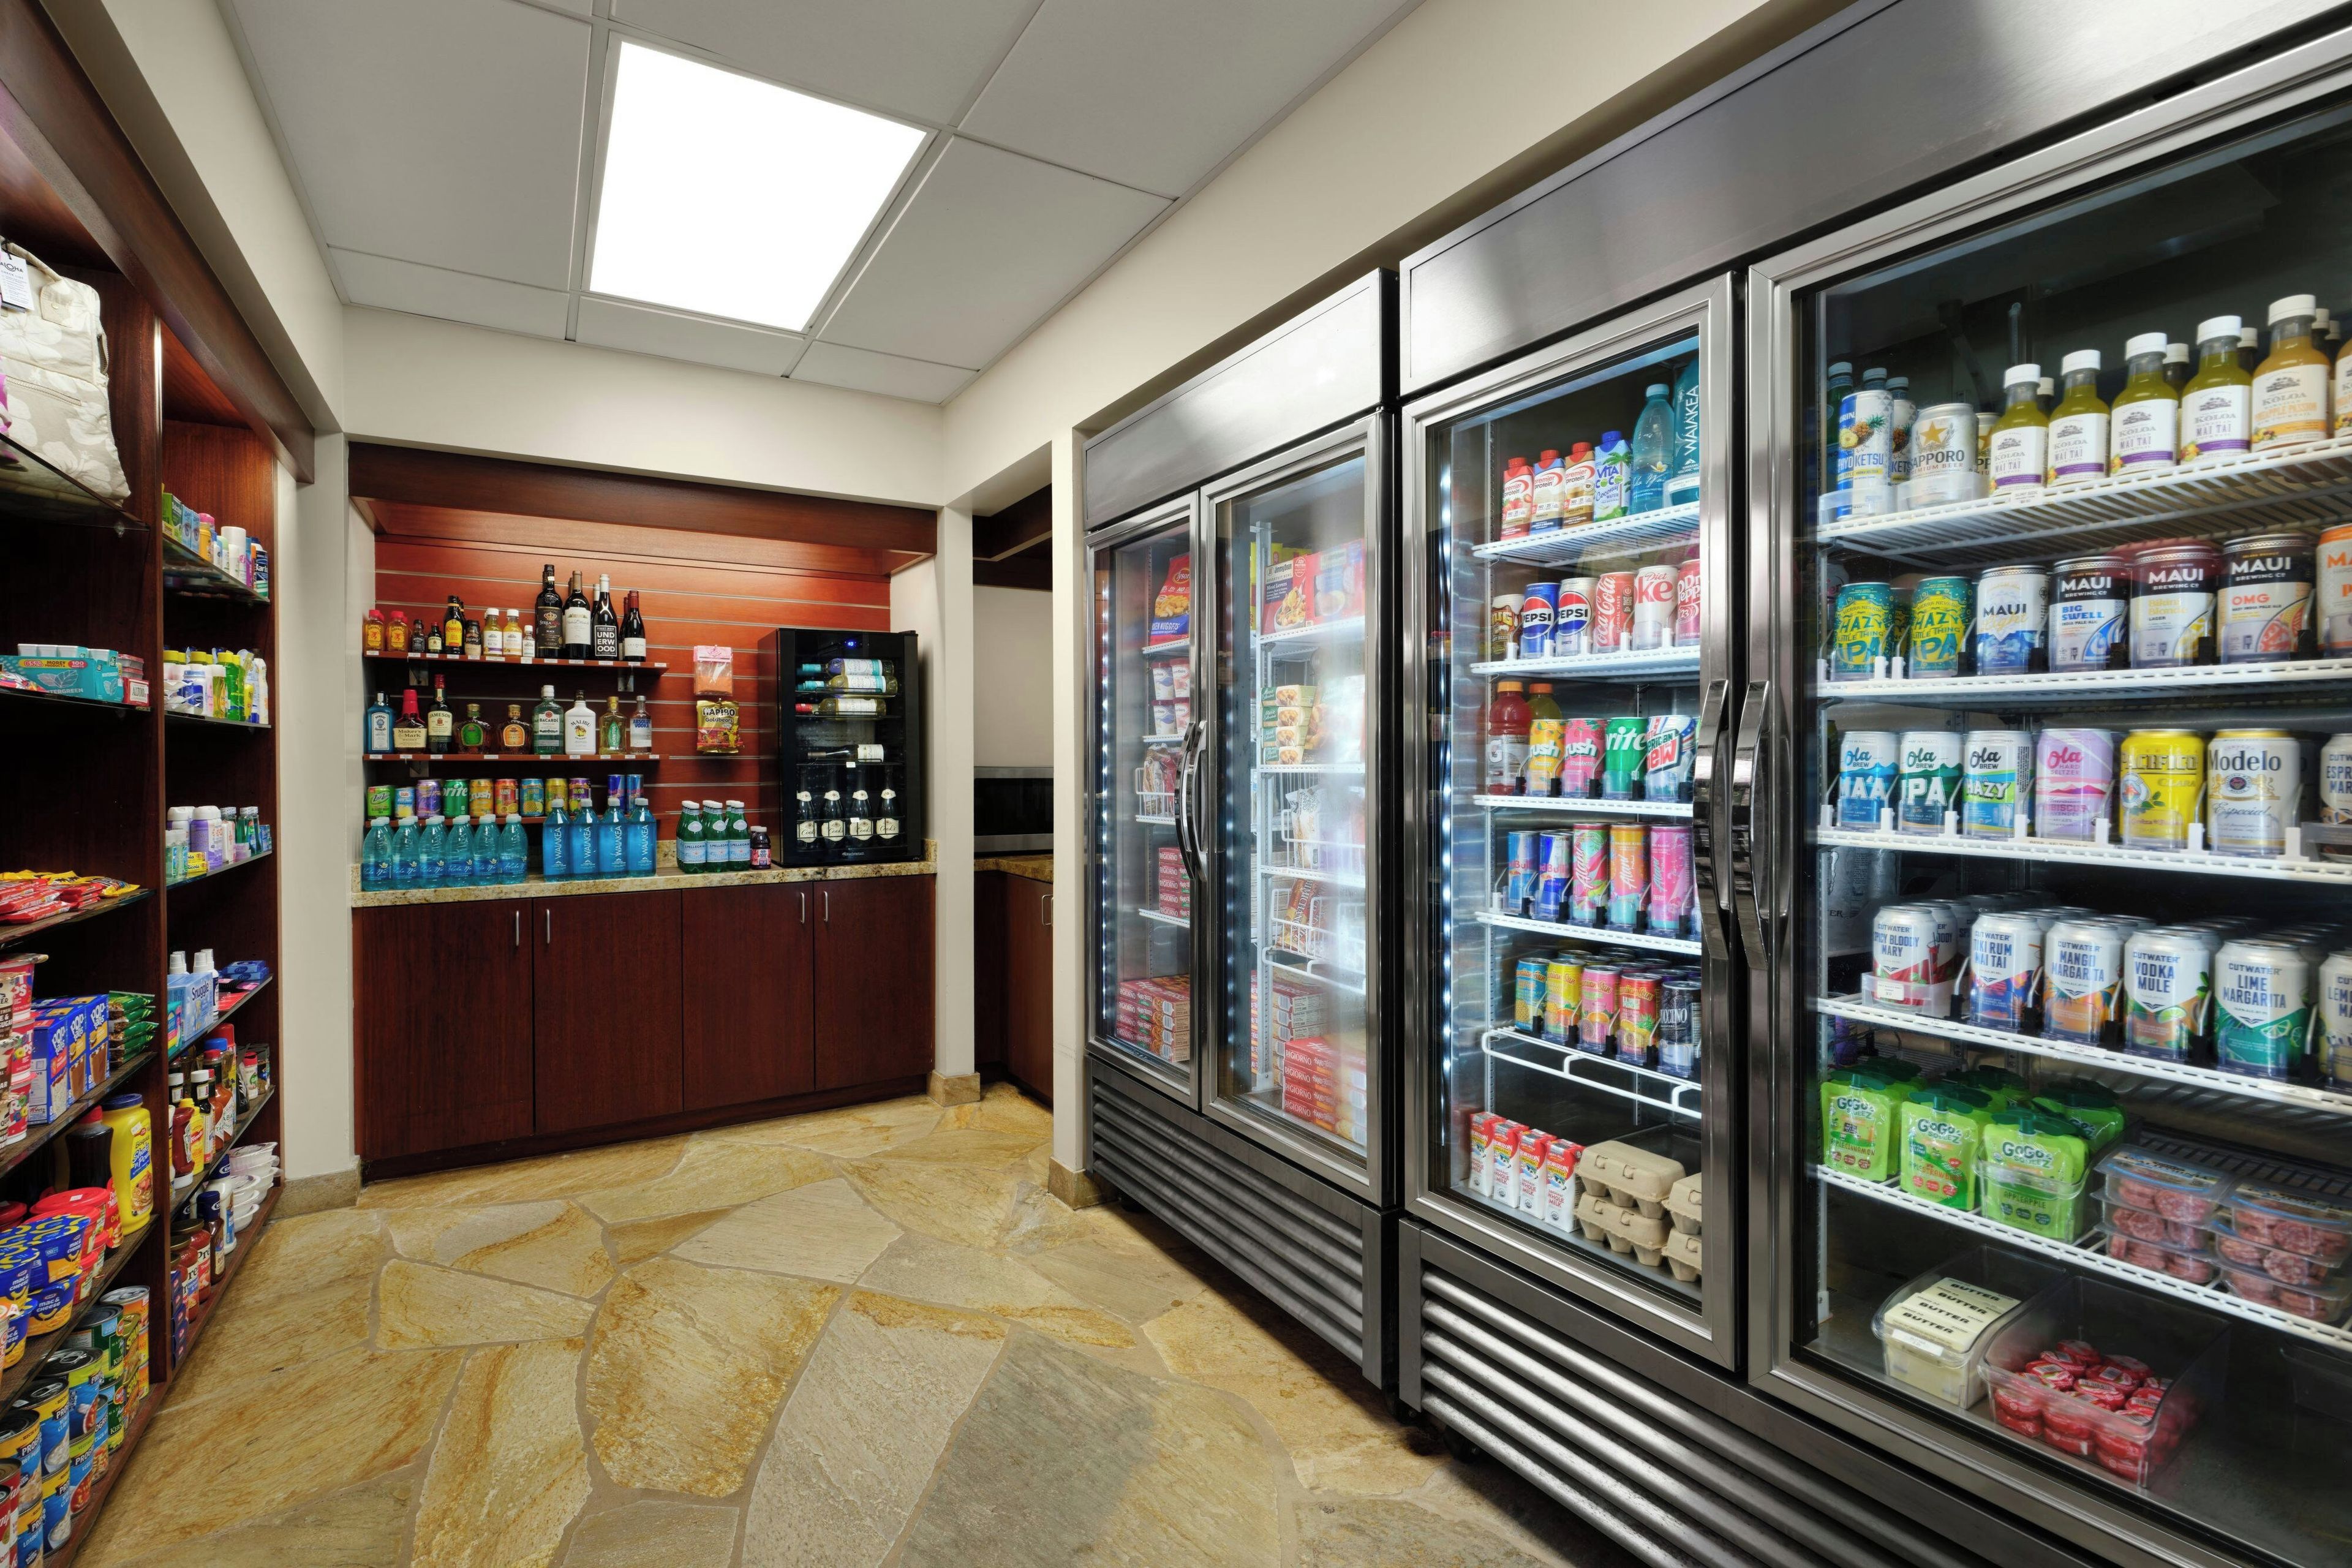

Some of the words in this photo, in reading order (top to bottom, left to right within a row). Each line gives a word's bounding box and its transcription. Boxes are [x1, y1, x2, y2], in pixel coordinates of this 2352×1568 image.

[0, 262, 23, 272] ALOHA
[2196, 426, 2209, 437] MAI
[2217, 423, 2231, 432] TAI
[2120, 440, 2135, 450] MAI
[2136, 437, 2151, 447] TAI
[1910, 450, 1965, 469] SAPPORO
[2070, 449, 2083, 458] TAI
[1596, 464, 1619, 479] VITA
[2231, 557, 2291, 575] MAUI
[2061, 576, 2111, 592] MAUI
[2148, 568, 2204, 584] MAUI
[2231, 594, 2271, 606] OMG
[1983, 603, 2027, 617] MAUI
[2062, 605, 2082, 613] BIG
[2062, 612, 2105, 621] SWELL
[1840, 616, 1883, 632] HAZY
[1915, 612, 1958, 630] HAZY
[1565, 740, 1598, 759] rush
[1907, 747, 1937, 768] Ola
[2048, 746, 2084, 769] Ola
[1970, 747, 2002, 769] Ola
[2208, 750, 2282, 771] Modelo
[1901, 776, 1948, 806] IPA
[1878, 923, 1911, 933] CUTWATER
[1975, 930, 2011, 941] CUTWATER
[1889, 935, 1920, 948] BLOODY
[1989, 941, 2012, 956] RUM
[2057, 941, 2101, 952] CUTWATER
[1882, 945, 1902, 957] MARY
[2060, 950, 2095, 967] MANGO
[2133, 951, 2180, 963] CUTWATER
[1991, 954, 2007, 969] TAI
[2228, 963, 2282, 975] CUTWATER
[2135, 962, 2174, 979] VODKA
[192, 980, 209, 1001] Snuggle
[2138, 976, 2170, 993] MULE
[2237, 974, 2267, 991] LIME
[2223, 987, 2286, 1008] MARGARITA
[1950, 1283, 2001, 1302] BUTTER
[1937, 1292, 1988, 1314] BUTTER
[1918, 1302, 1970, 1324] BUTTER
[1902, 1312, 1954, 1334] BUTTER
